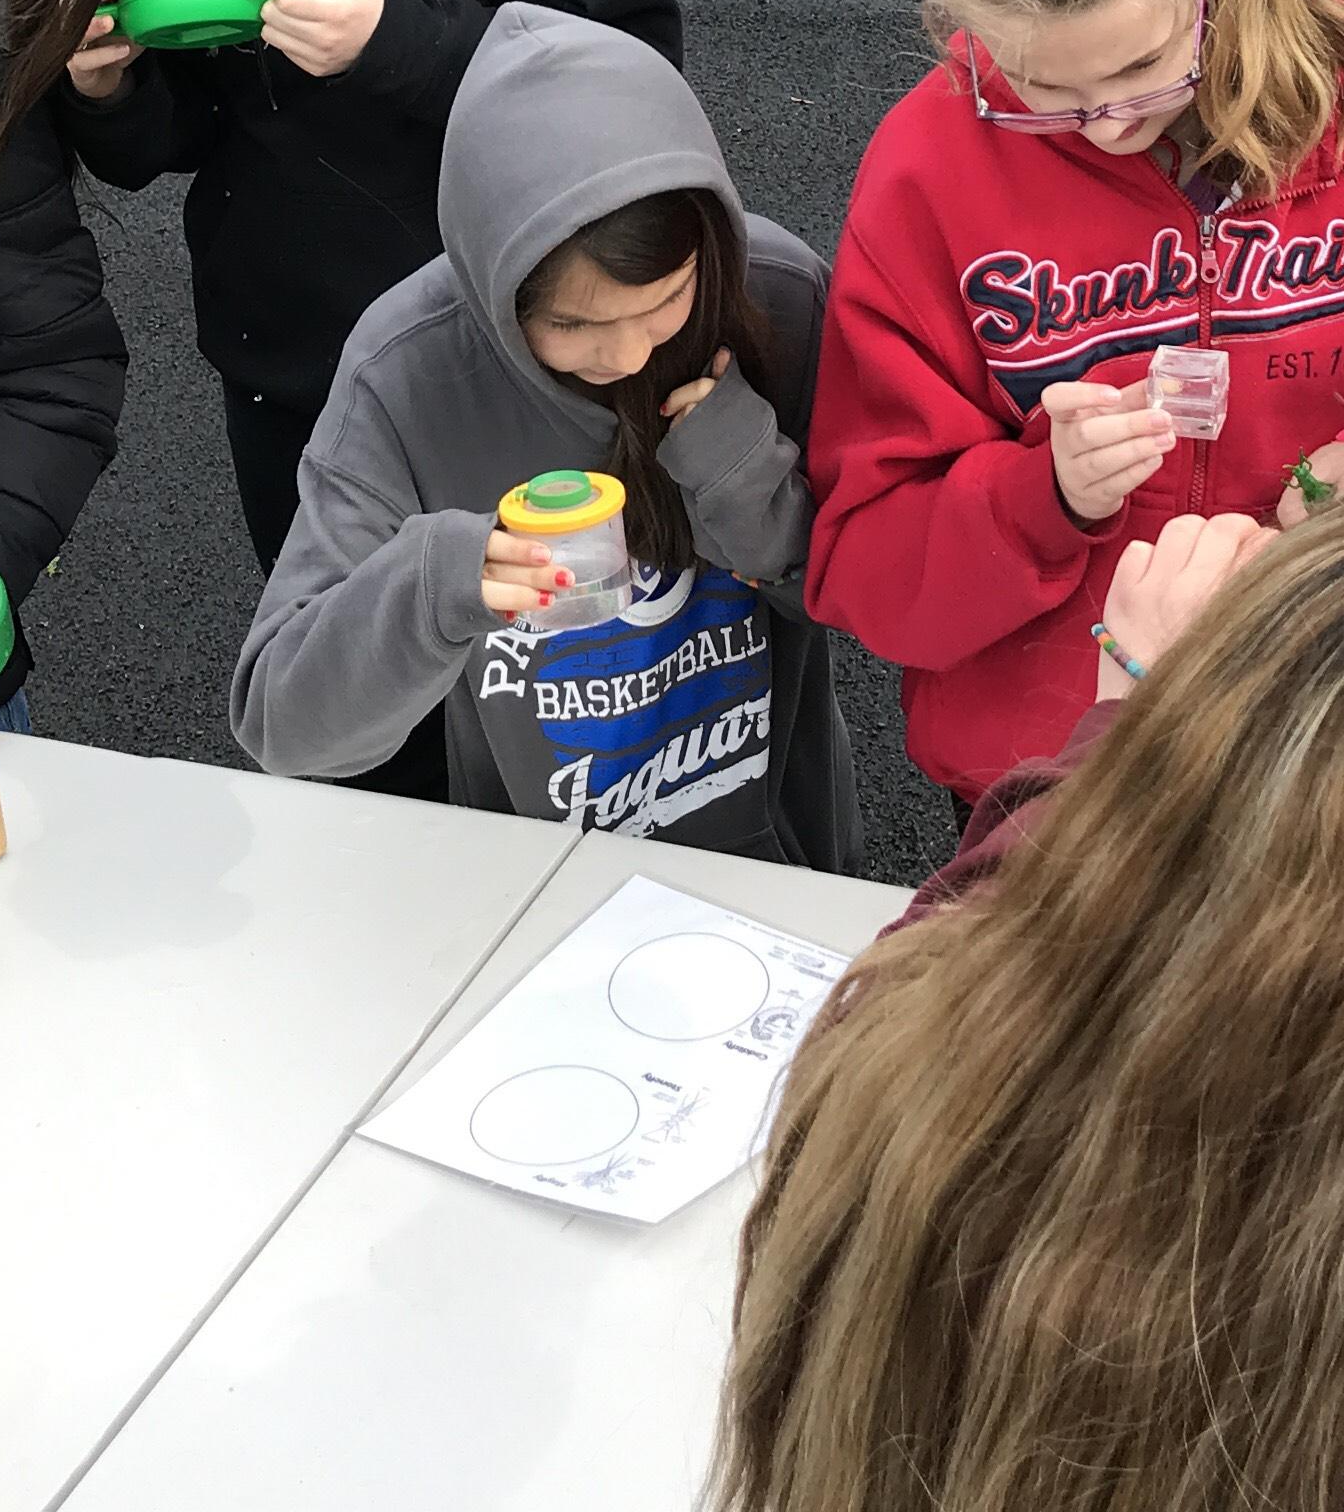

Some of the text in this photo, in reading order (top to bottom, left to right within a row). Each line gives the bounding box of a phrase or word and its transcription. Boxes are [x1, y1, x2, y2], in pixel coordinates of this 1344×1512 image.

[960, 228, 1202, 349] Skunk
[1266, 351, 1318, 380] EST.
[478, 627, 542, 700] PA
[533, 616, 767, 721] BASKETBALL
[548, 689, 771, 830] Jaguar
